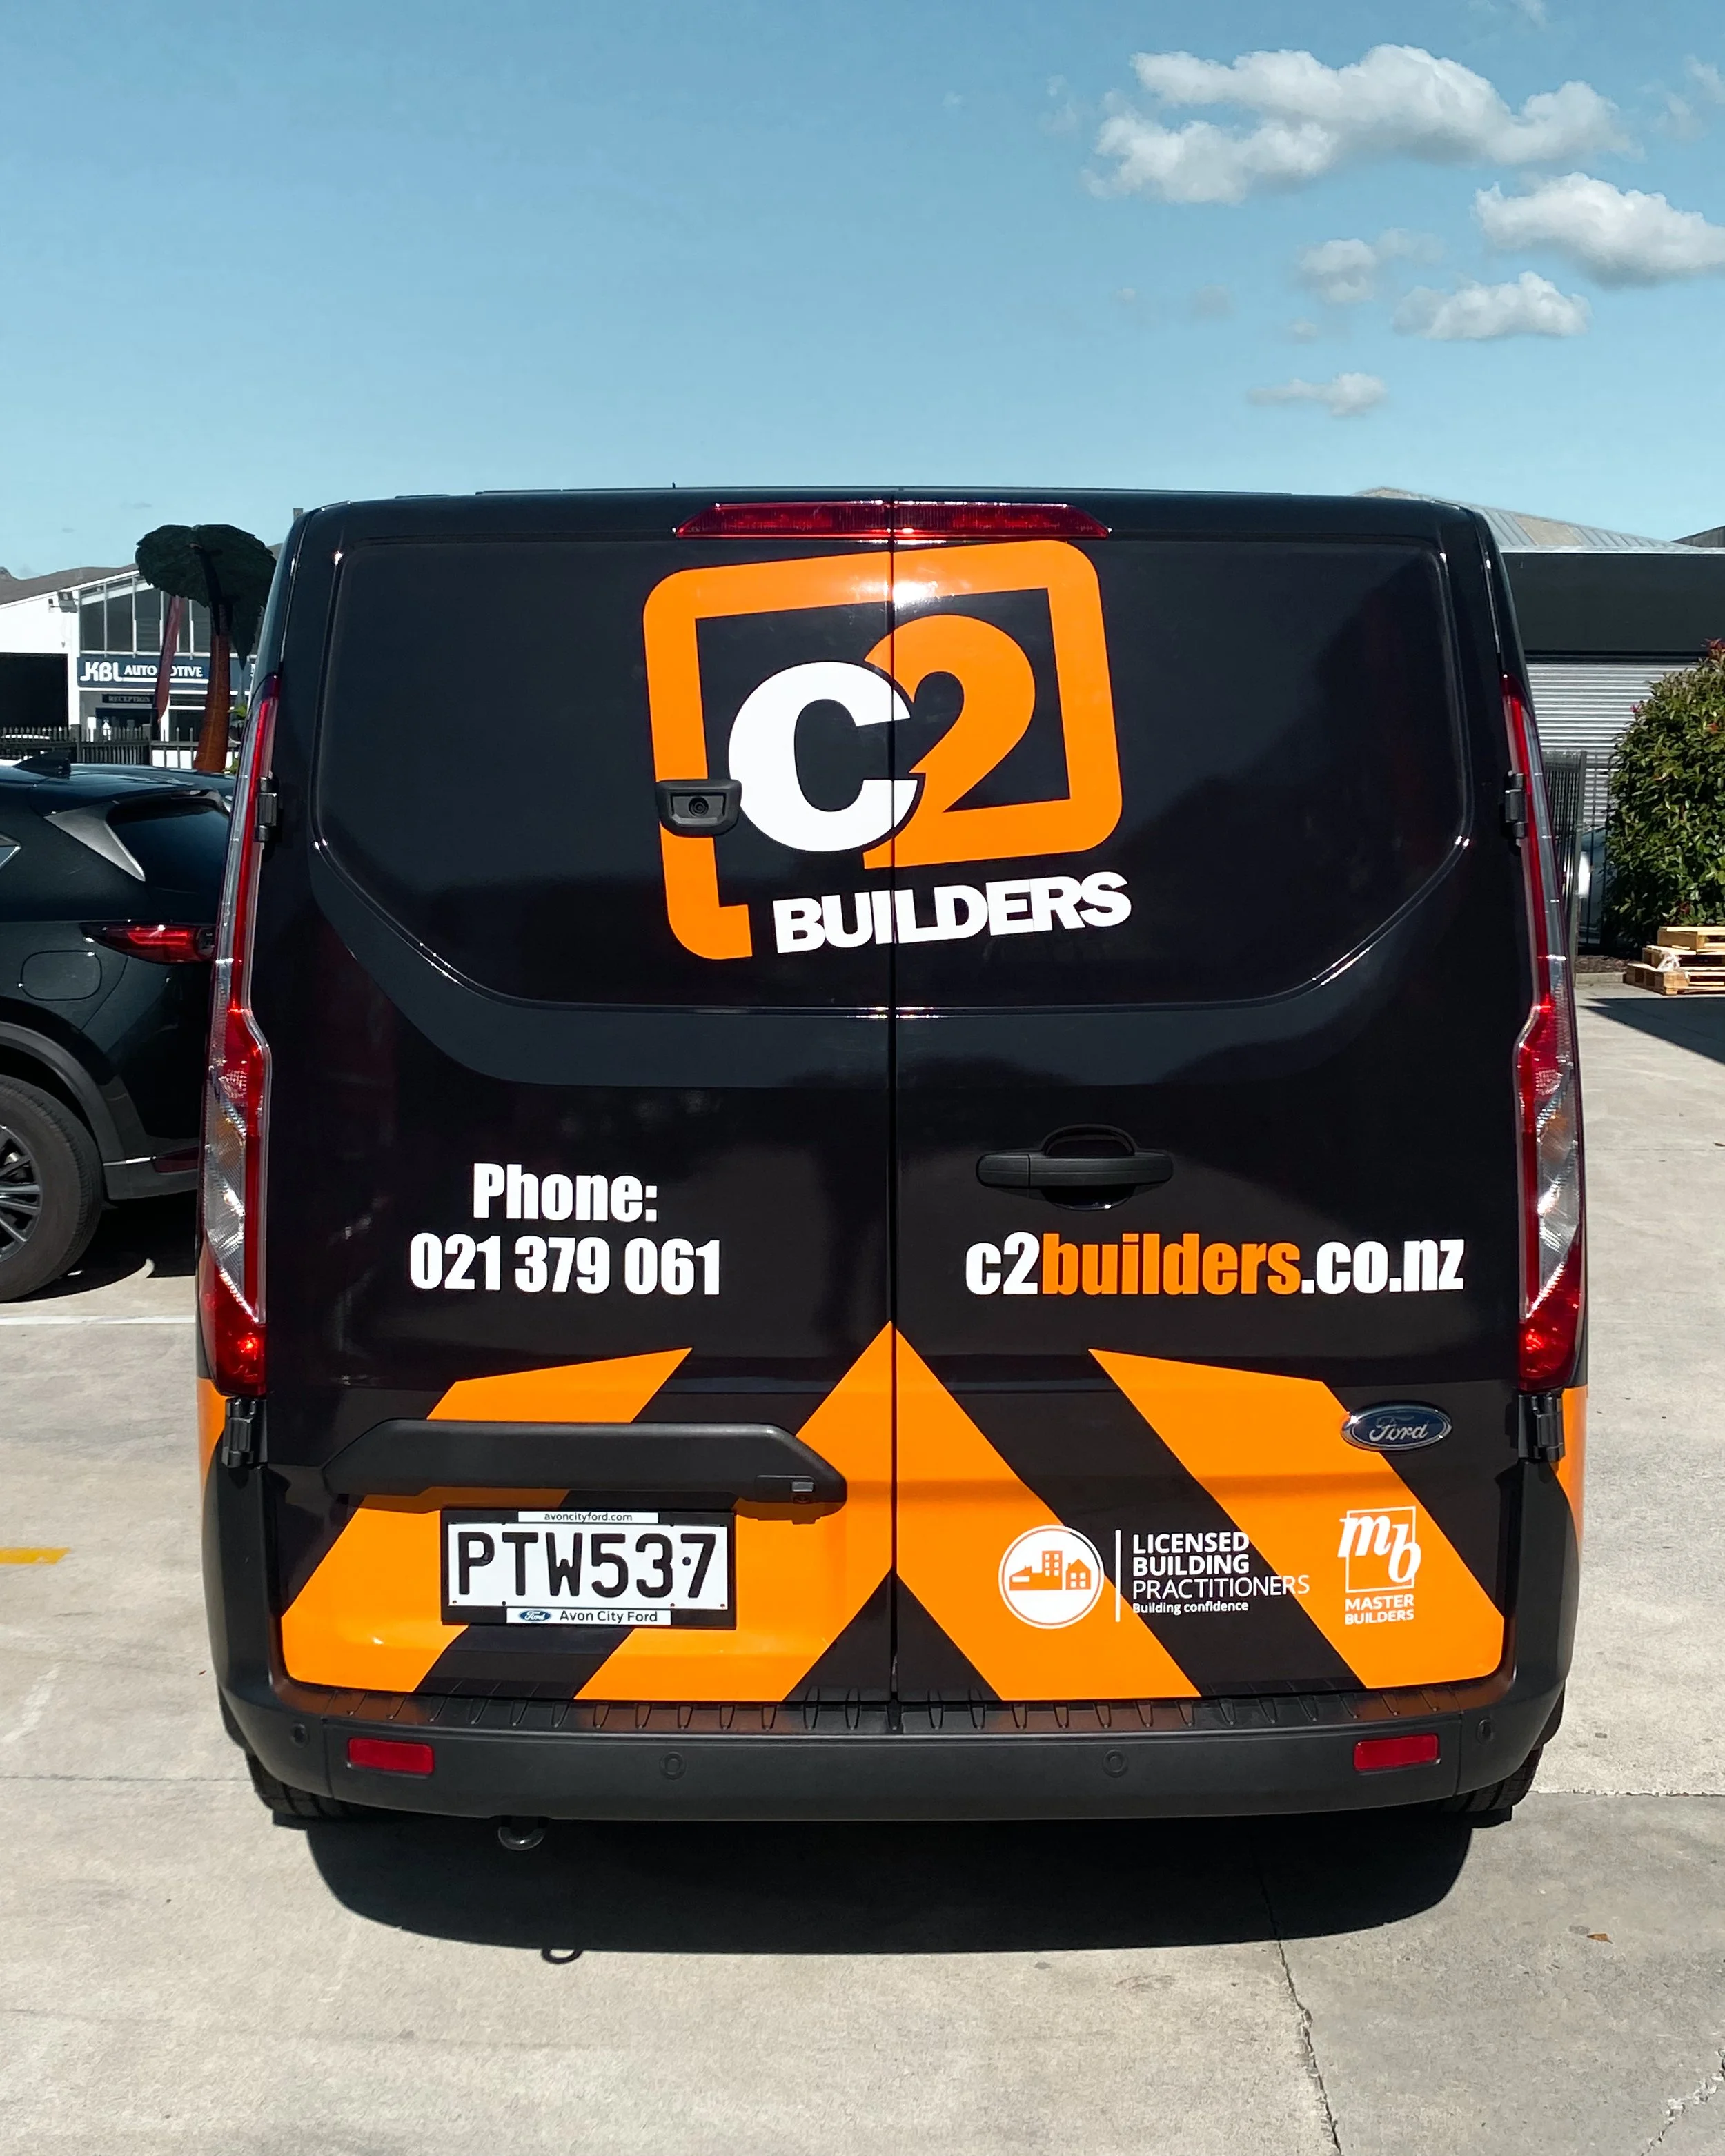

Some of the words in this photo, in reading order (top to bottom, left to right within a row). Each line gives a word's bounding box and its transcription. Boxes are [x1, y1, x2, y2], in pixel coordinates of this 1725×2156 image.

[124, 664, 204, 678] AUTOOTIVE
[773, 871, 1132, 953] BUILDERS
[473, 1163, 658, 1223] Phone:
[410, 1232, 501, 1290] 021
[515, 1235, 611, 1294] 379
[624, 1238, 720, 1295] 061
[965, 1231, 1466, 1296] c2builders.co.nz
[1369, 1414, 1430, 1442] Ford
[544, 1512, 633, 1522] avoncityford.com
[1133, 1532, 1250, 1554] LICENSED
[458, 1532, 716, 1598] PTW537
[1133, 1554, 1249, 1576] BUILDING
[1133, 1575, 1310, 1599] PRACTITIONERS
[1133, 1603, 1181, 1615] Building
[1184, 1601, 1248, 1613] confidence
[1346, 1594, 1414, 1611] MASTER
[560, 1610, 593, 1621] Avon
[597, 1611, 623, 1623] City
[627, 1612, 658, 1621] Ford
[1345, 1609, 1414, 1625] BUILDERS
